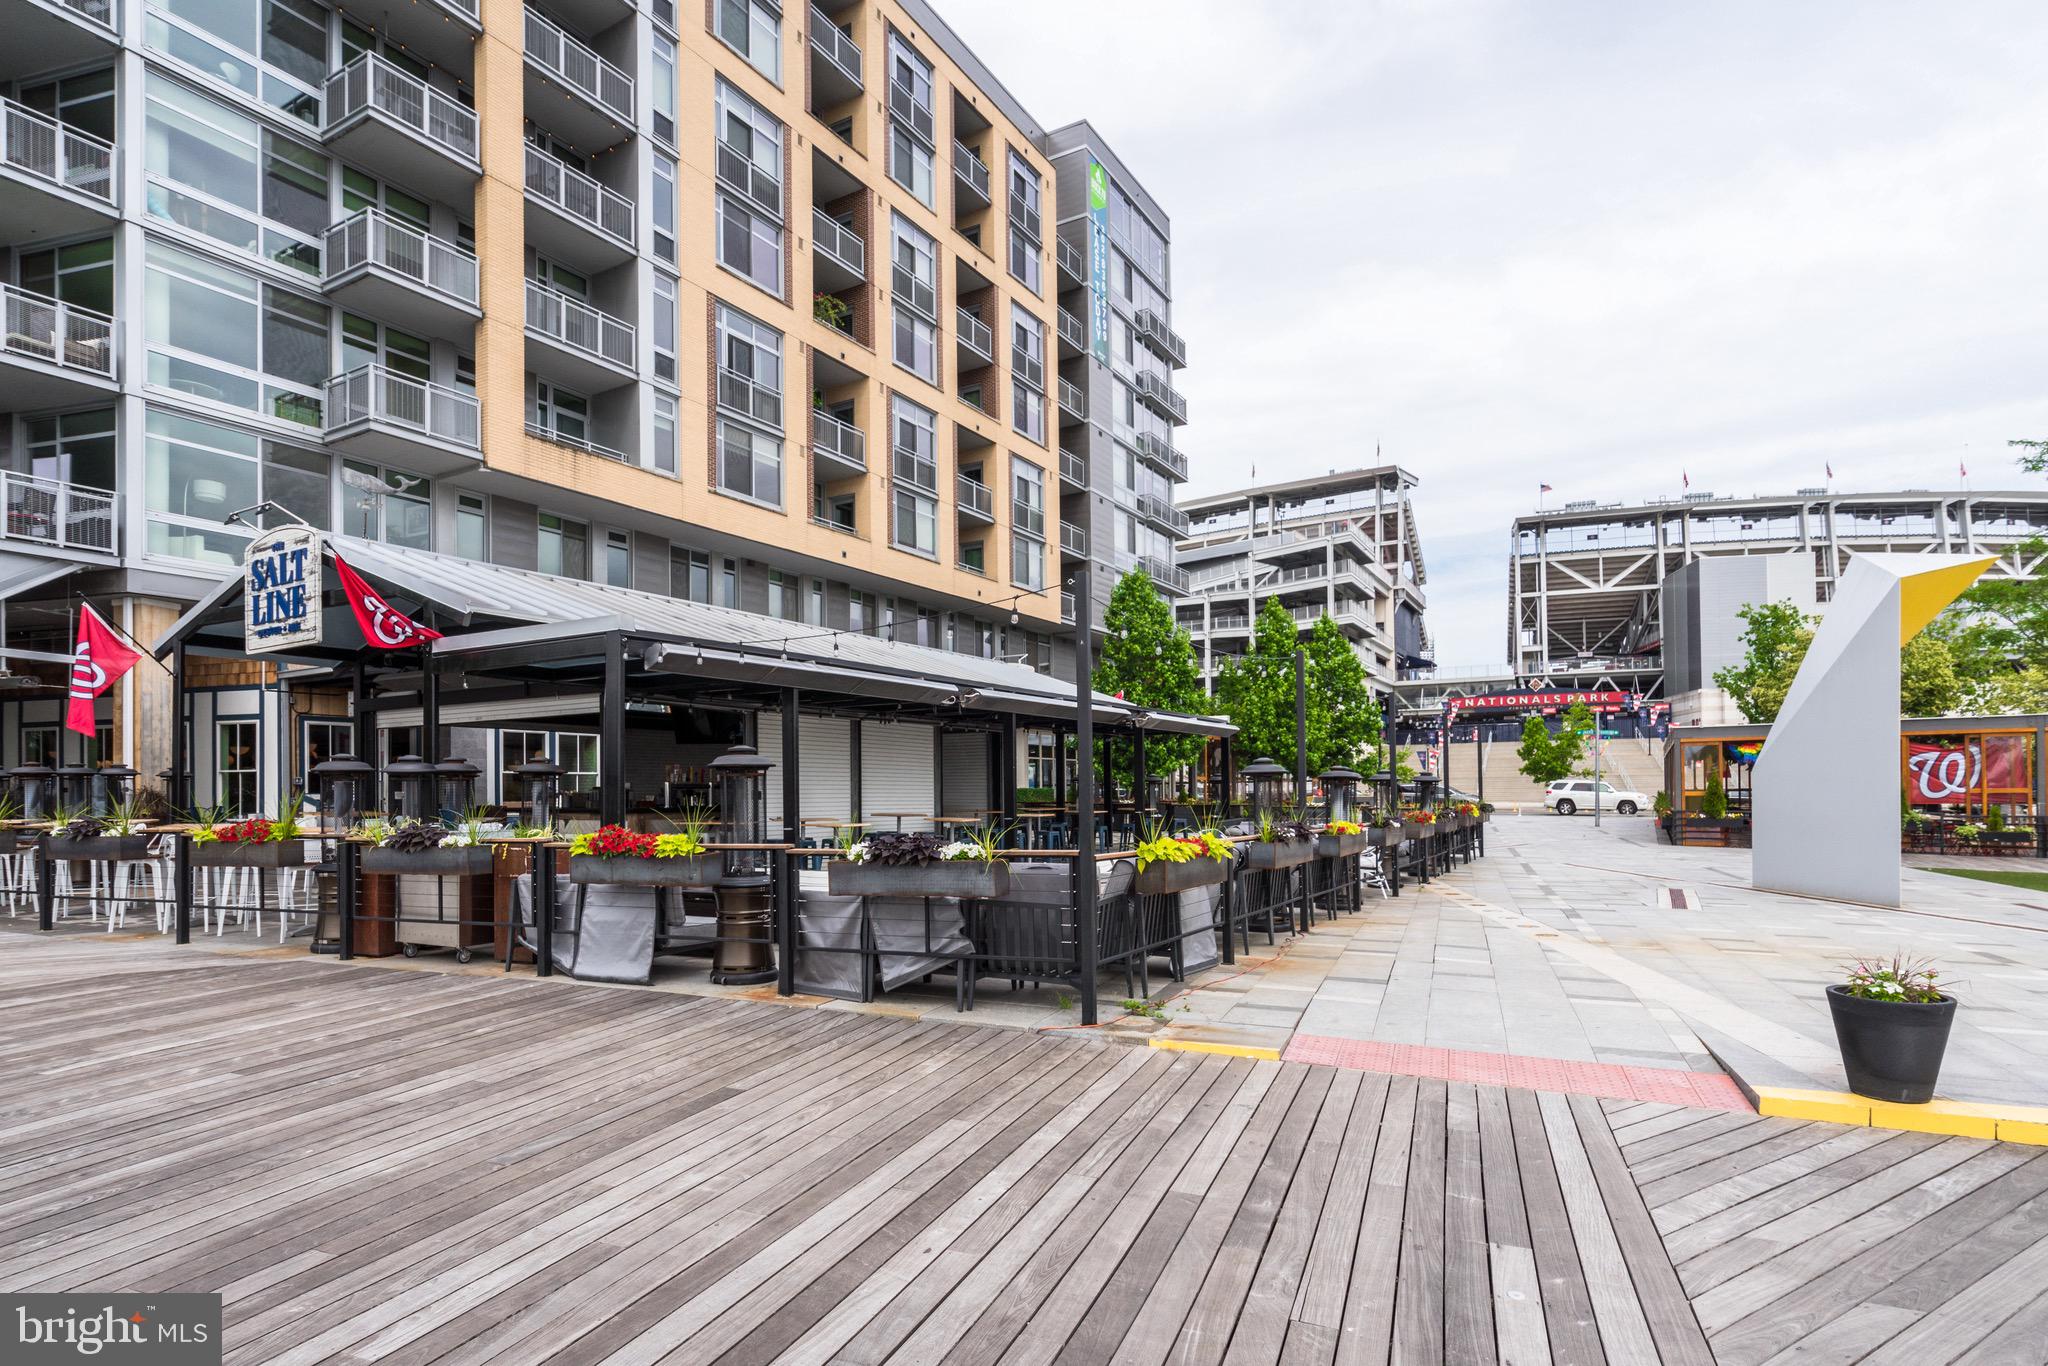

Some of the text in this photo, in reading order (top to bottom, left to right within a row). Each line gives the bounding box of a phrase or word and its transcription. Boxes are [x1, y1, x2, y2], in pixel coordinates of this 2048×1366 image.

[251, 548, 308, 592] SALT
[252, 584, 307, 626] LINE
[1465, 693, 1609, 707] NATIONALS PARK
